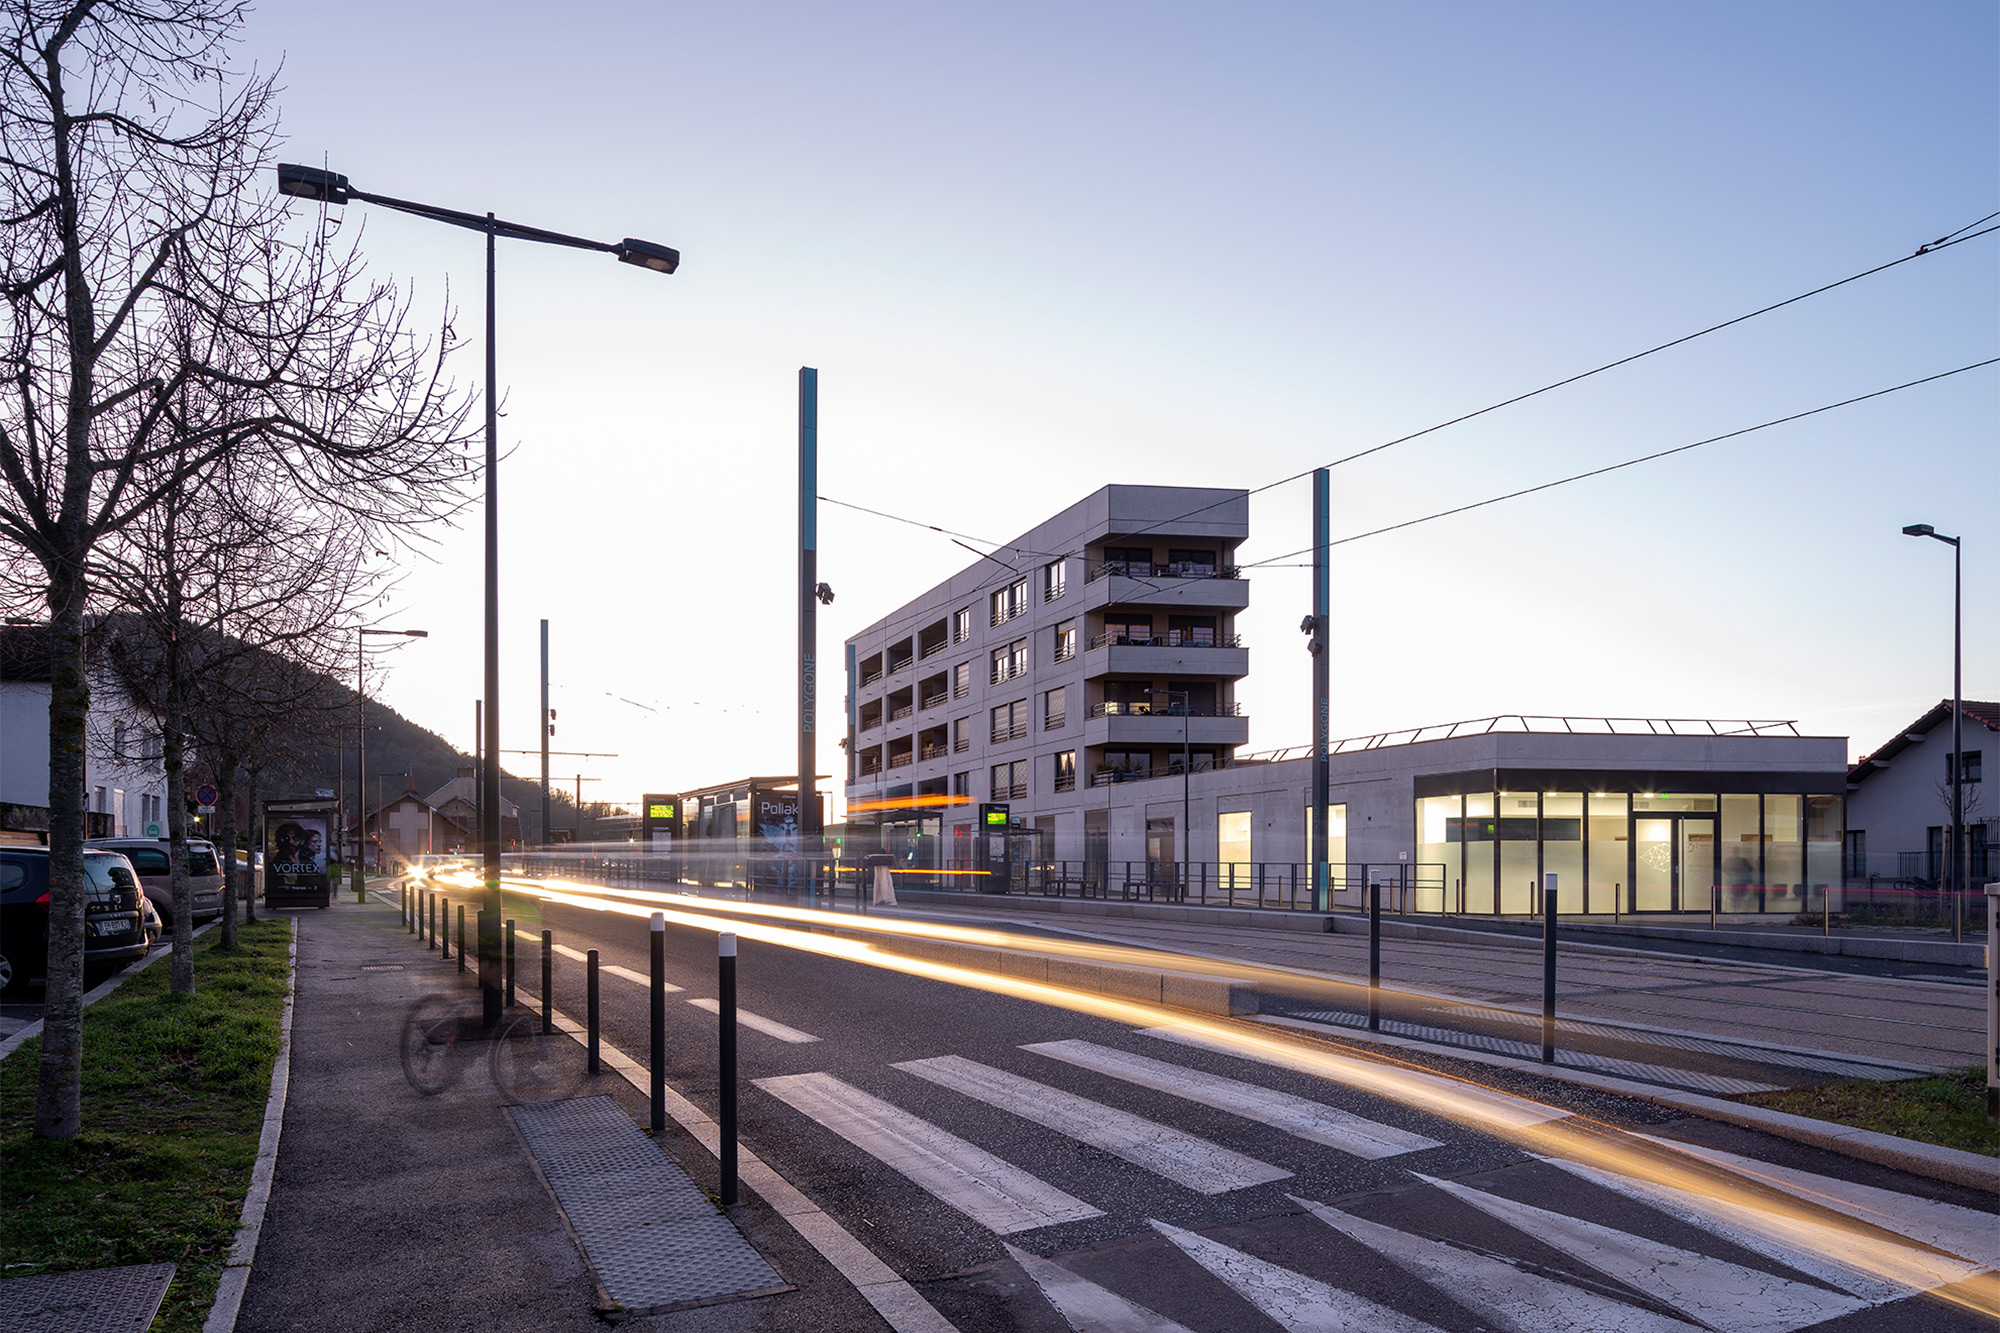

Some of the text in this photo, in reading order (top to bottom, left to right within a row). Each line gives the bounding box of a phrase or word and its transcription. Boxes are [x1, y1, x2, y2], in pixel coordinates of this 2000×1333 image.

[803, 653, 815, 733] POLYGONE
[1320, 698, 1328, 762] POLYGONE
[273, 863, 321, 873] VORTEX
